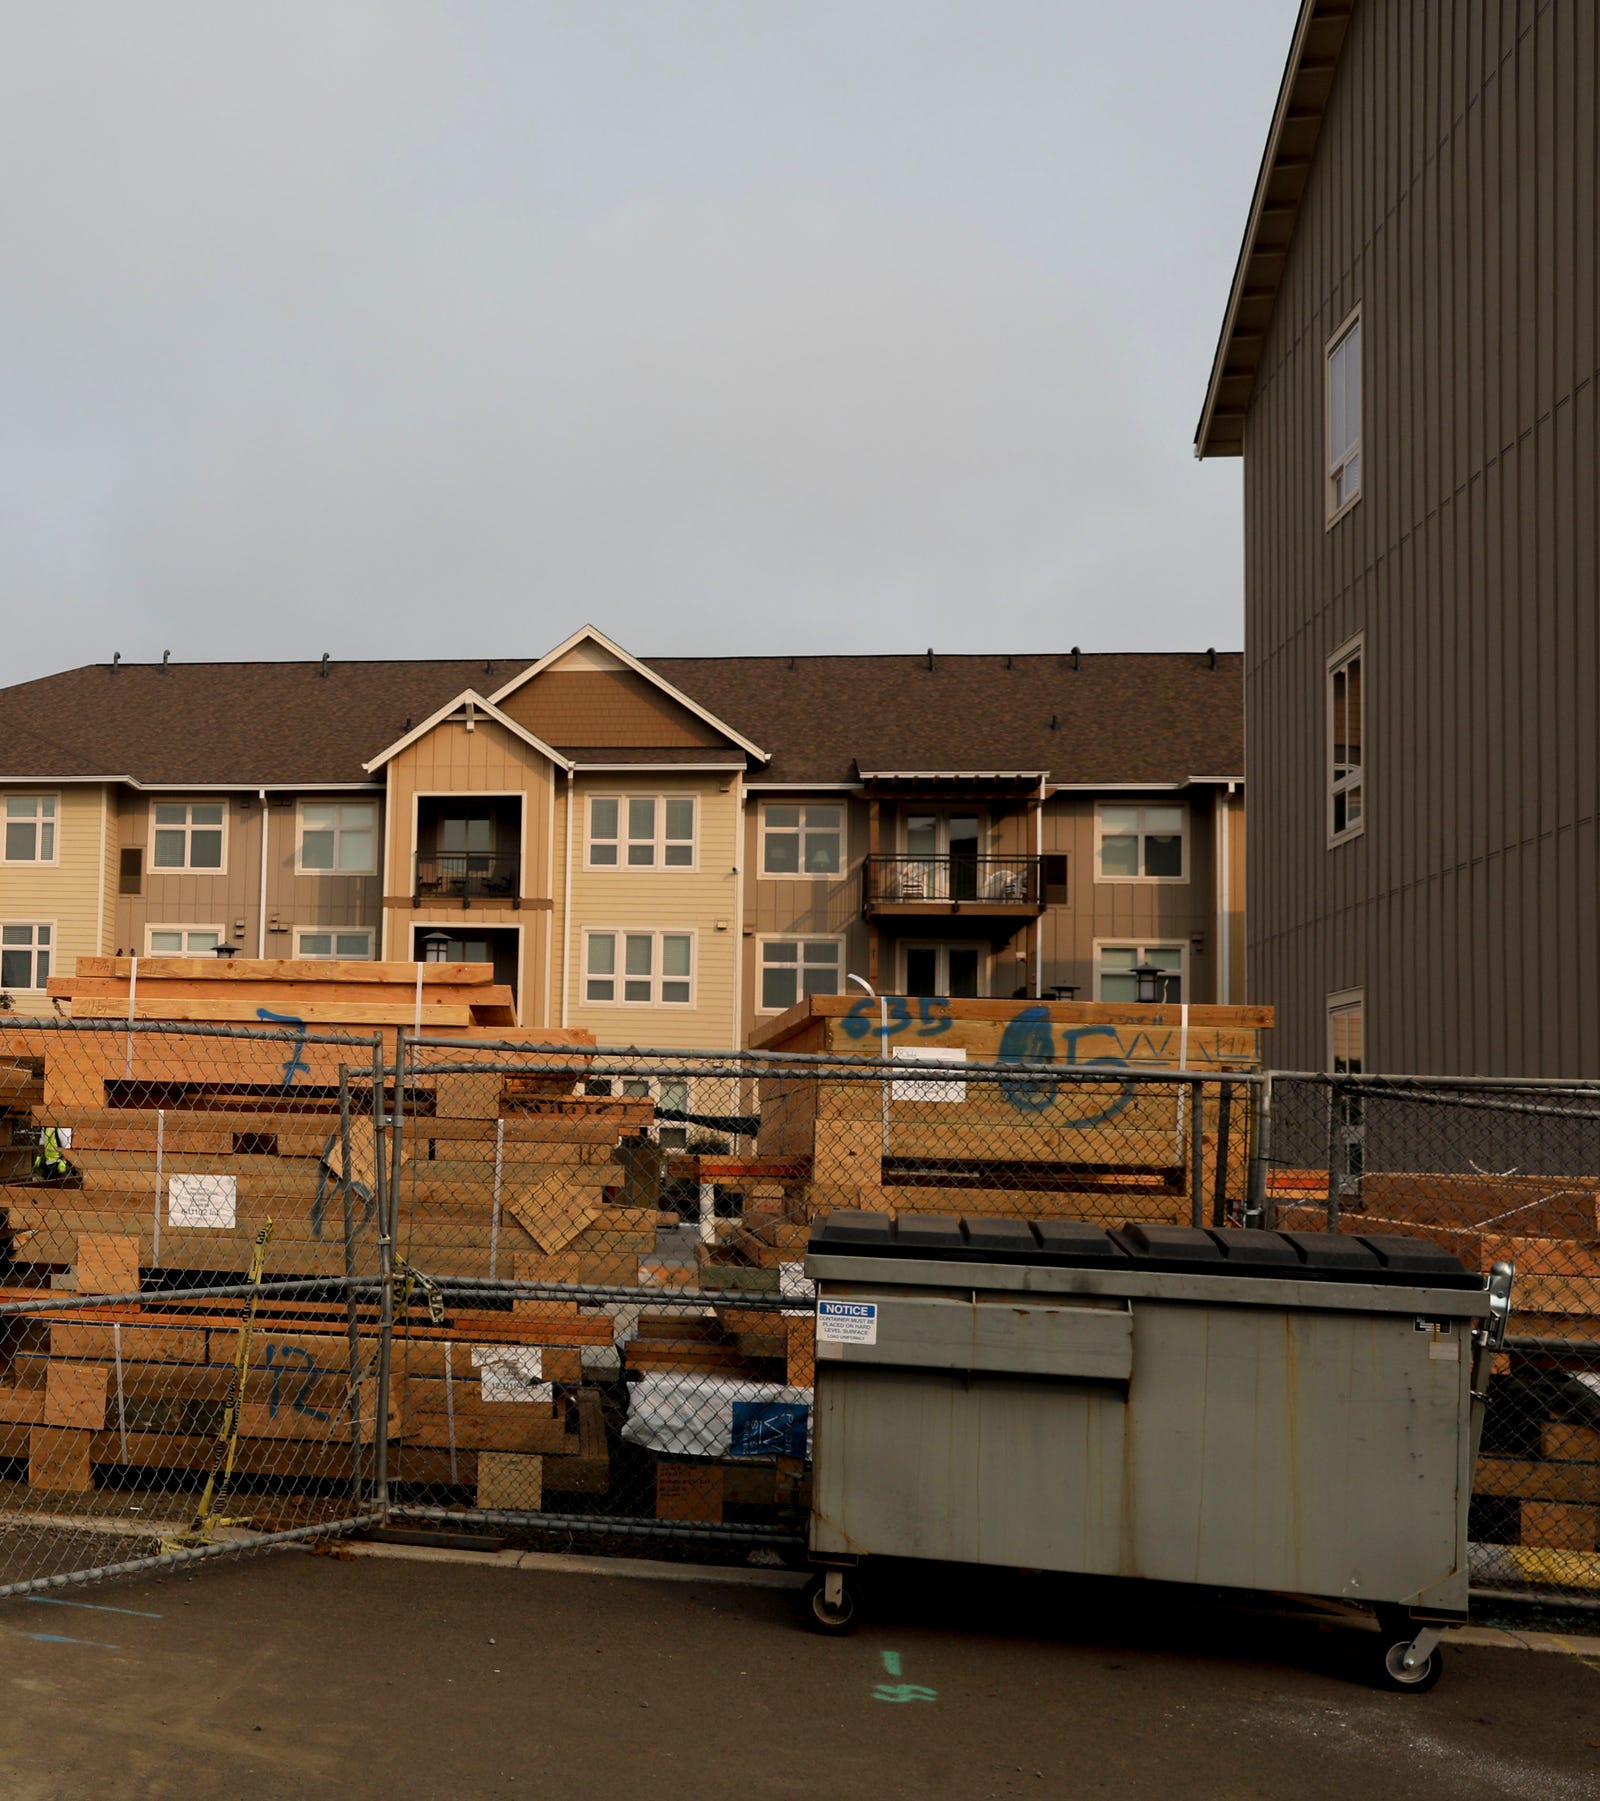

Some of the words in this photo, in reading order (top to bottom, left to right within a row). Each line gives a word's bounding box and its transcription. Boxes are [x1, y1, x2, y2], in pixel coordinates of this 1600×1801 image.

[256, 1008, 311, 1087] 7
[839, 997, 953, 1039] 635
[825, 1304, 868, 1316] NOTICE
[266, 1344, 331, 1421] 12
